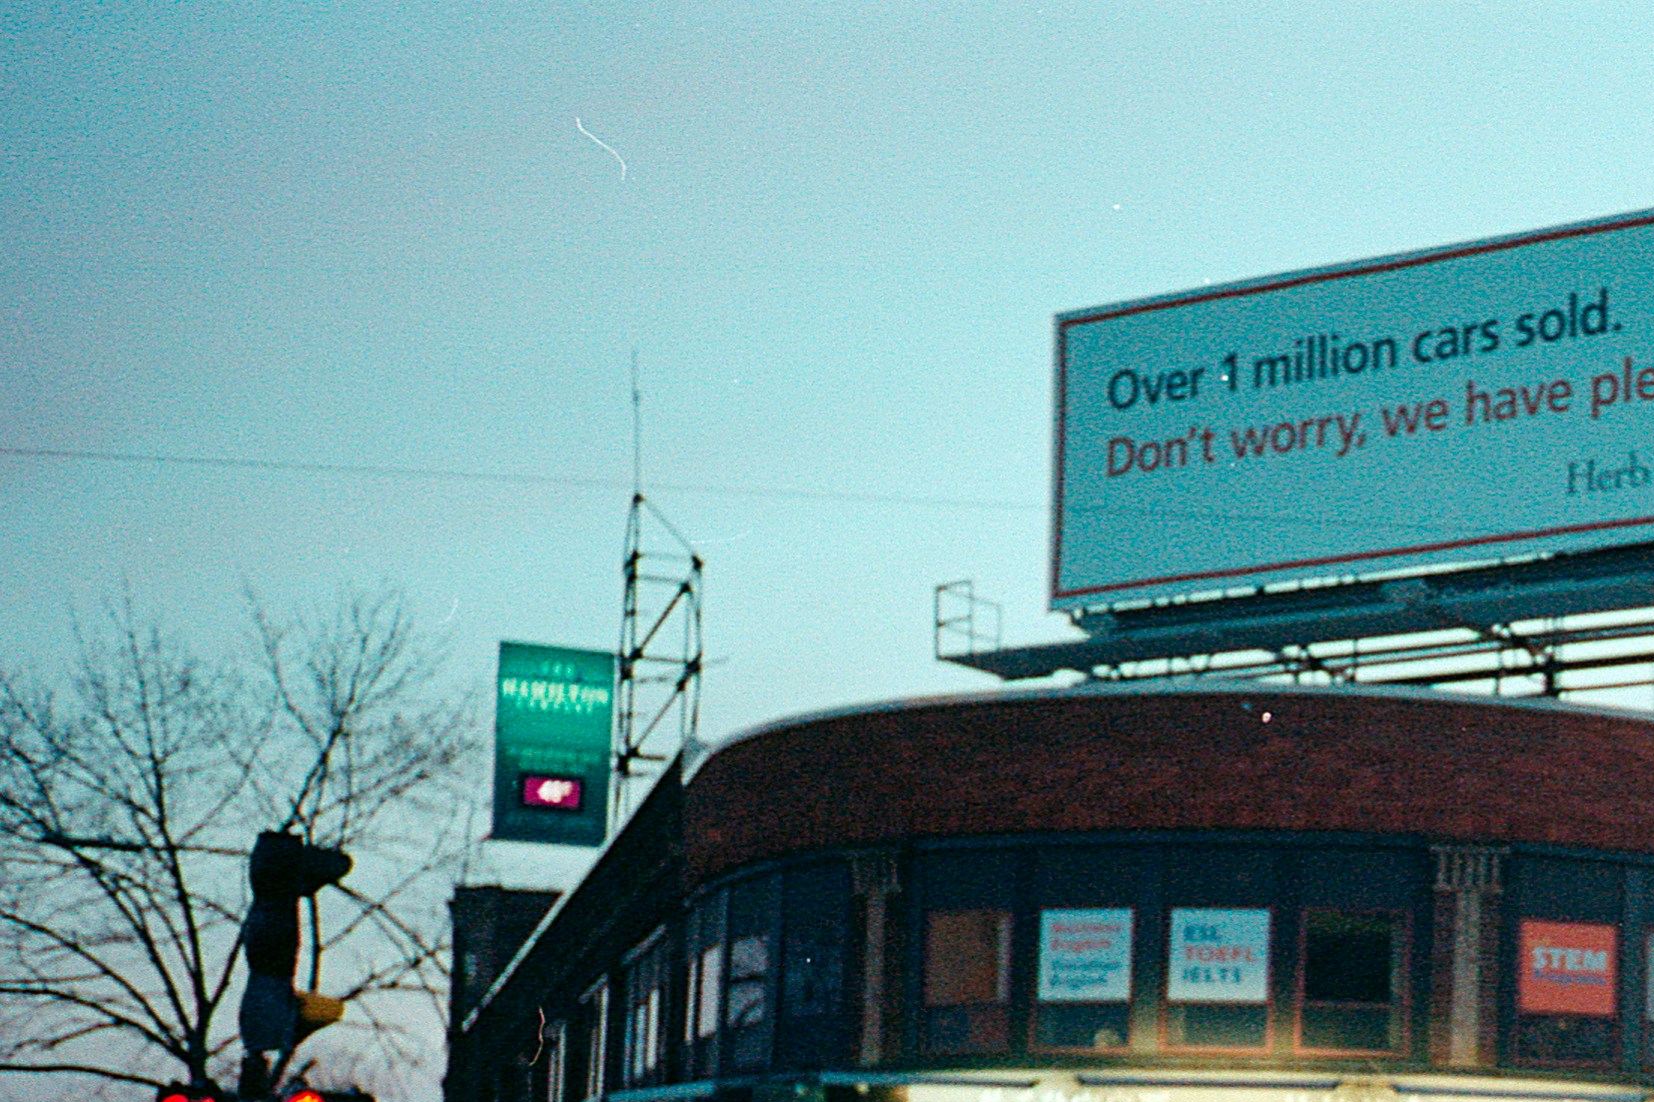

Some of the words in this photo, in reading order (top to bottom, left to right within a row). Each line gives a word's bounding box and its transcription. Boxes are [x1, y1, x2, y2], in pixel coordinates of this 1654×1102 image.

[1107, 366, 1205, 411] Over
[1221, 351, 1238, 393] 1
[1253, 334, 1397, 389] million
[1412, 318, 1500, 364] cars
[1515, 286, 1622, 347] sold.
[1106, 424, 1216, 478] Don't
[1230, 412, 1366, 459] worry,
[1382, 399, 1449, 437] we
[1465, 379, 1572, 426] have
[1566, 455, 1650, 495] Herb
[1183, 944, 1259, 963] TOEFL
[1531, 946, 1608, 972] STEM
